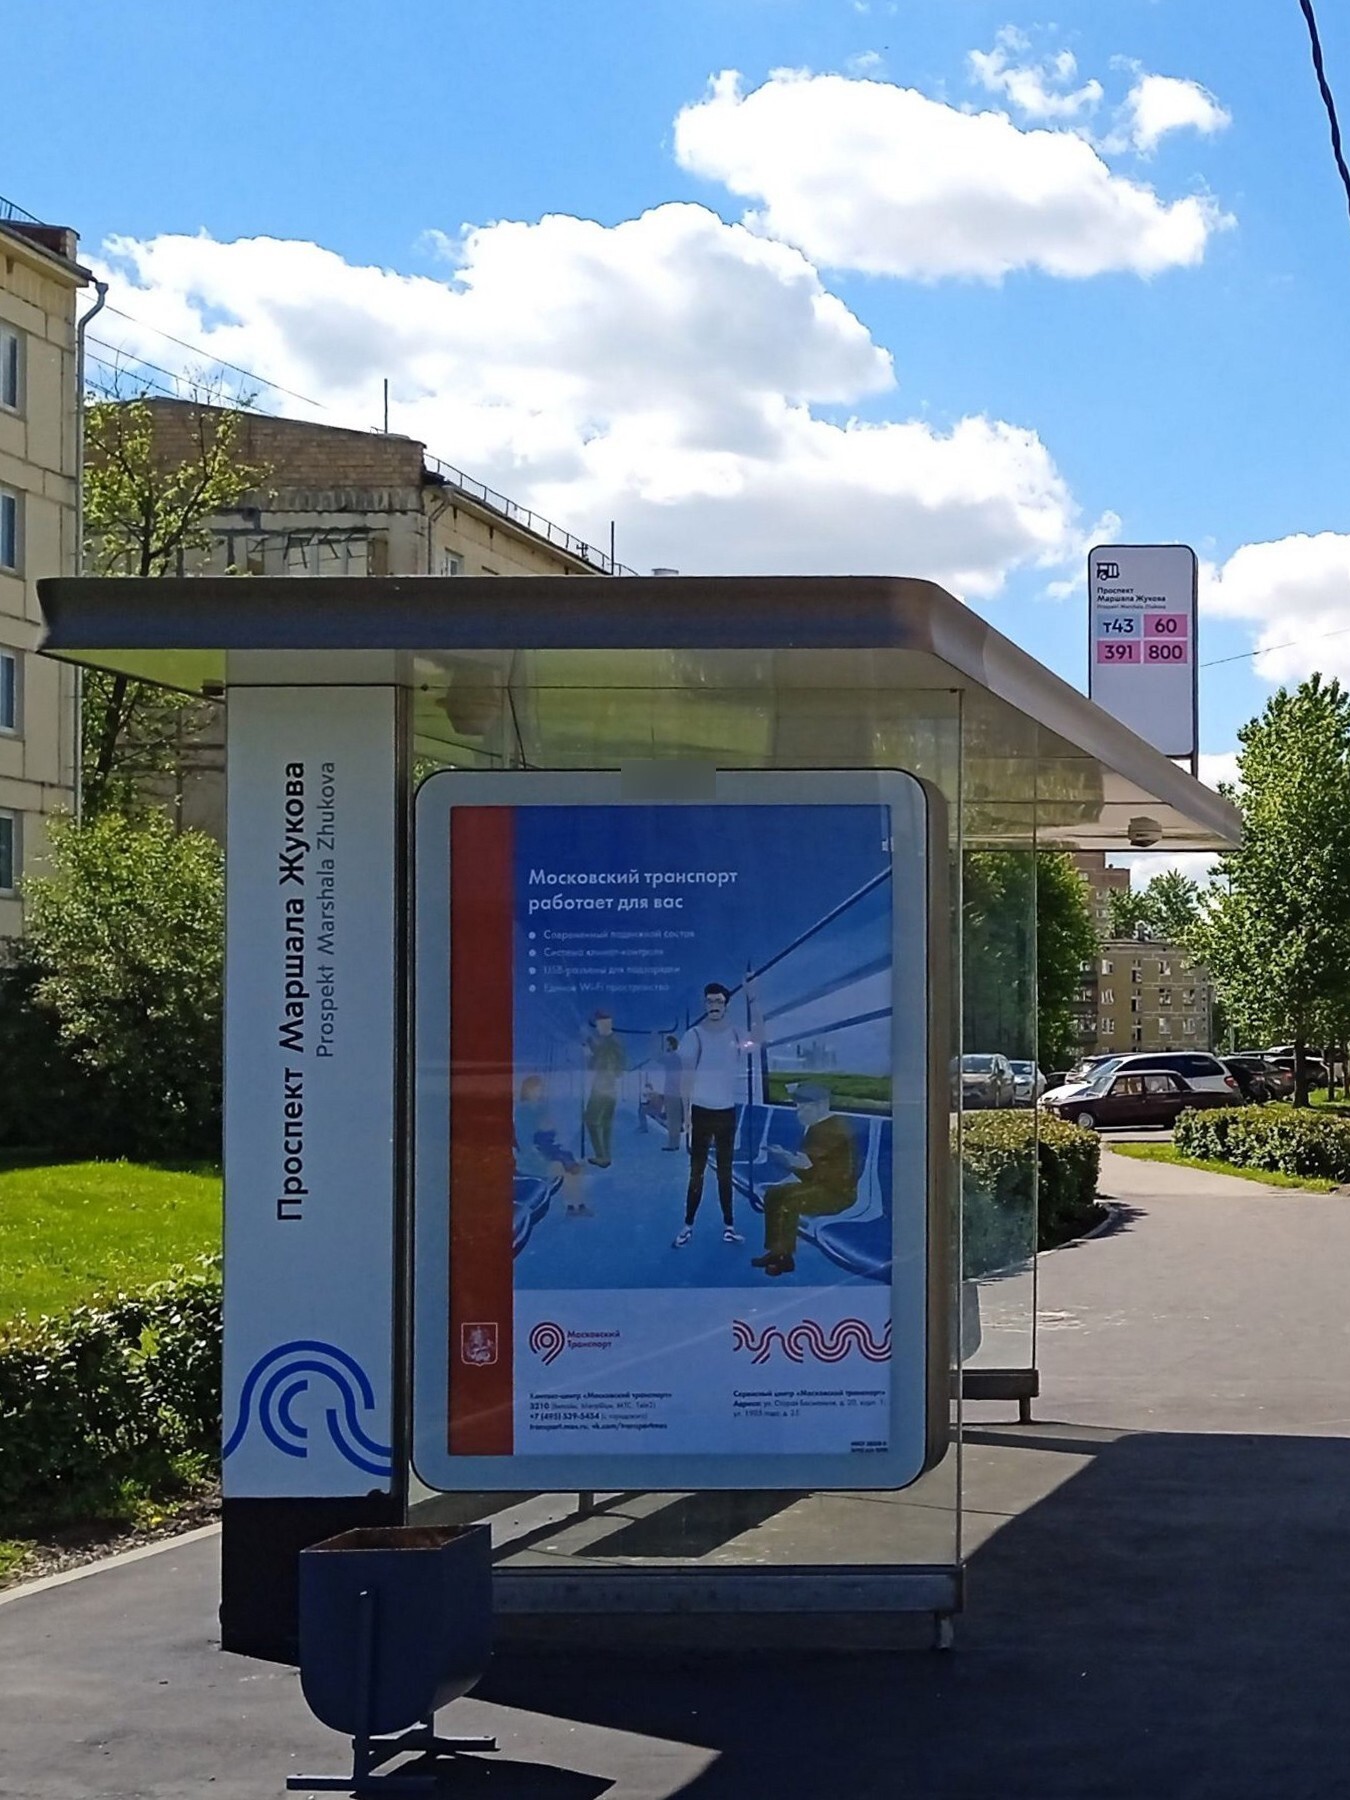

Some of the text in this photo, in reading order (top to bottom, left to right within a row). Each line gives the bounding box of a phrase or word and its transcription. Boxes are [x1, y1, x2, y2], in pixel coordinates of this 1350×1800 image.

[1097, 587, 1134, 595] Проспект
[1097, 595, 1166, 604] Маршала Жукова
[1103, 618, 1134, 633] т43
[1155, 618, 1177, 633] 60
[1104, 645, 1133, 660] 391
[1149, 645, 1183, 660] 800
[528, 869, 738, 888] Московский транспорт
[316, 761, 338, 1057] Prospekt Marshala Zhukova
[528, 893, 683, 915] работает для вас
[277, 762, 311, 1221] Проспект Маршала Жукова
[567, 1330, 621, 1338] Московский
[567, 1340, 612, 1349] Транспорт
